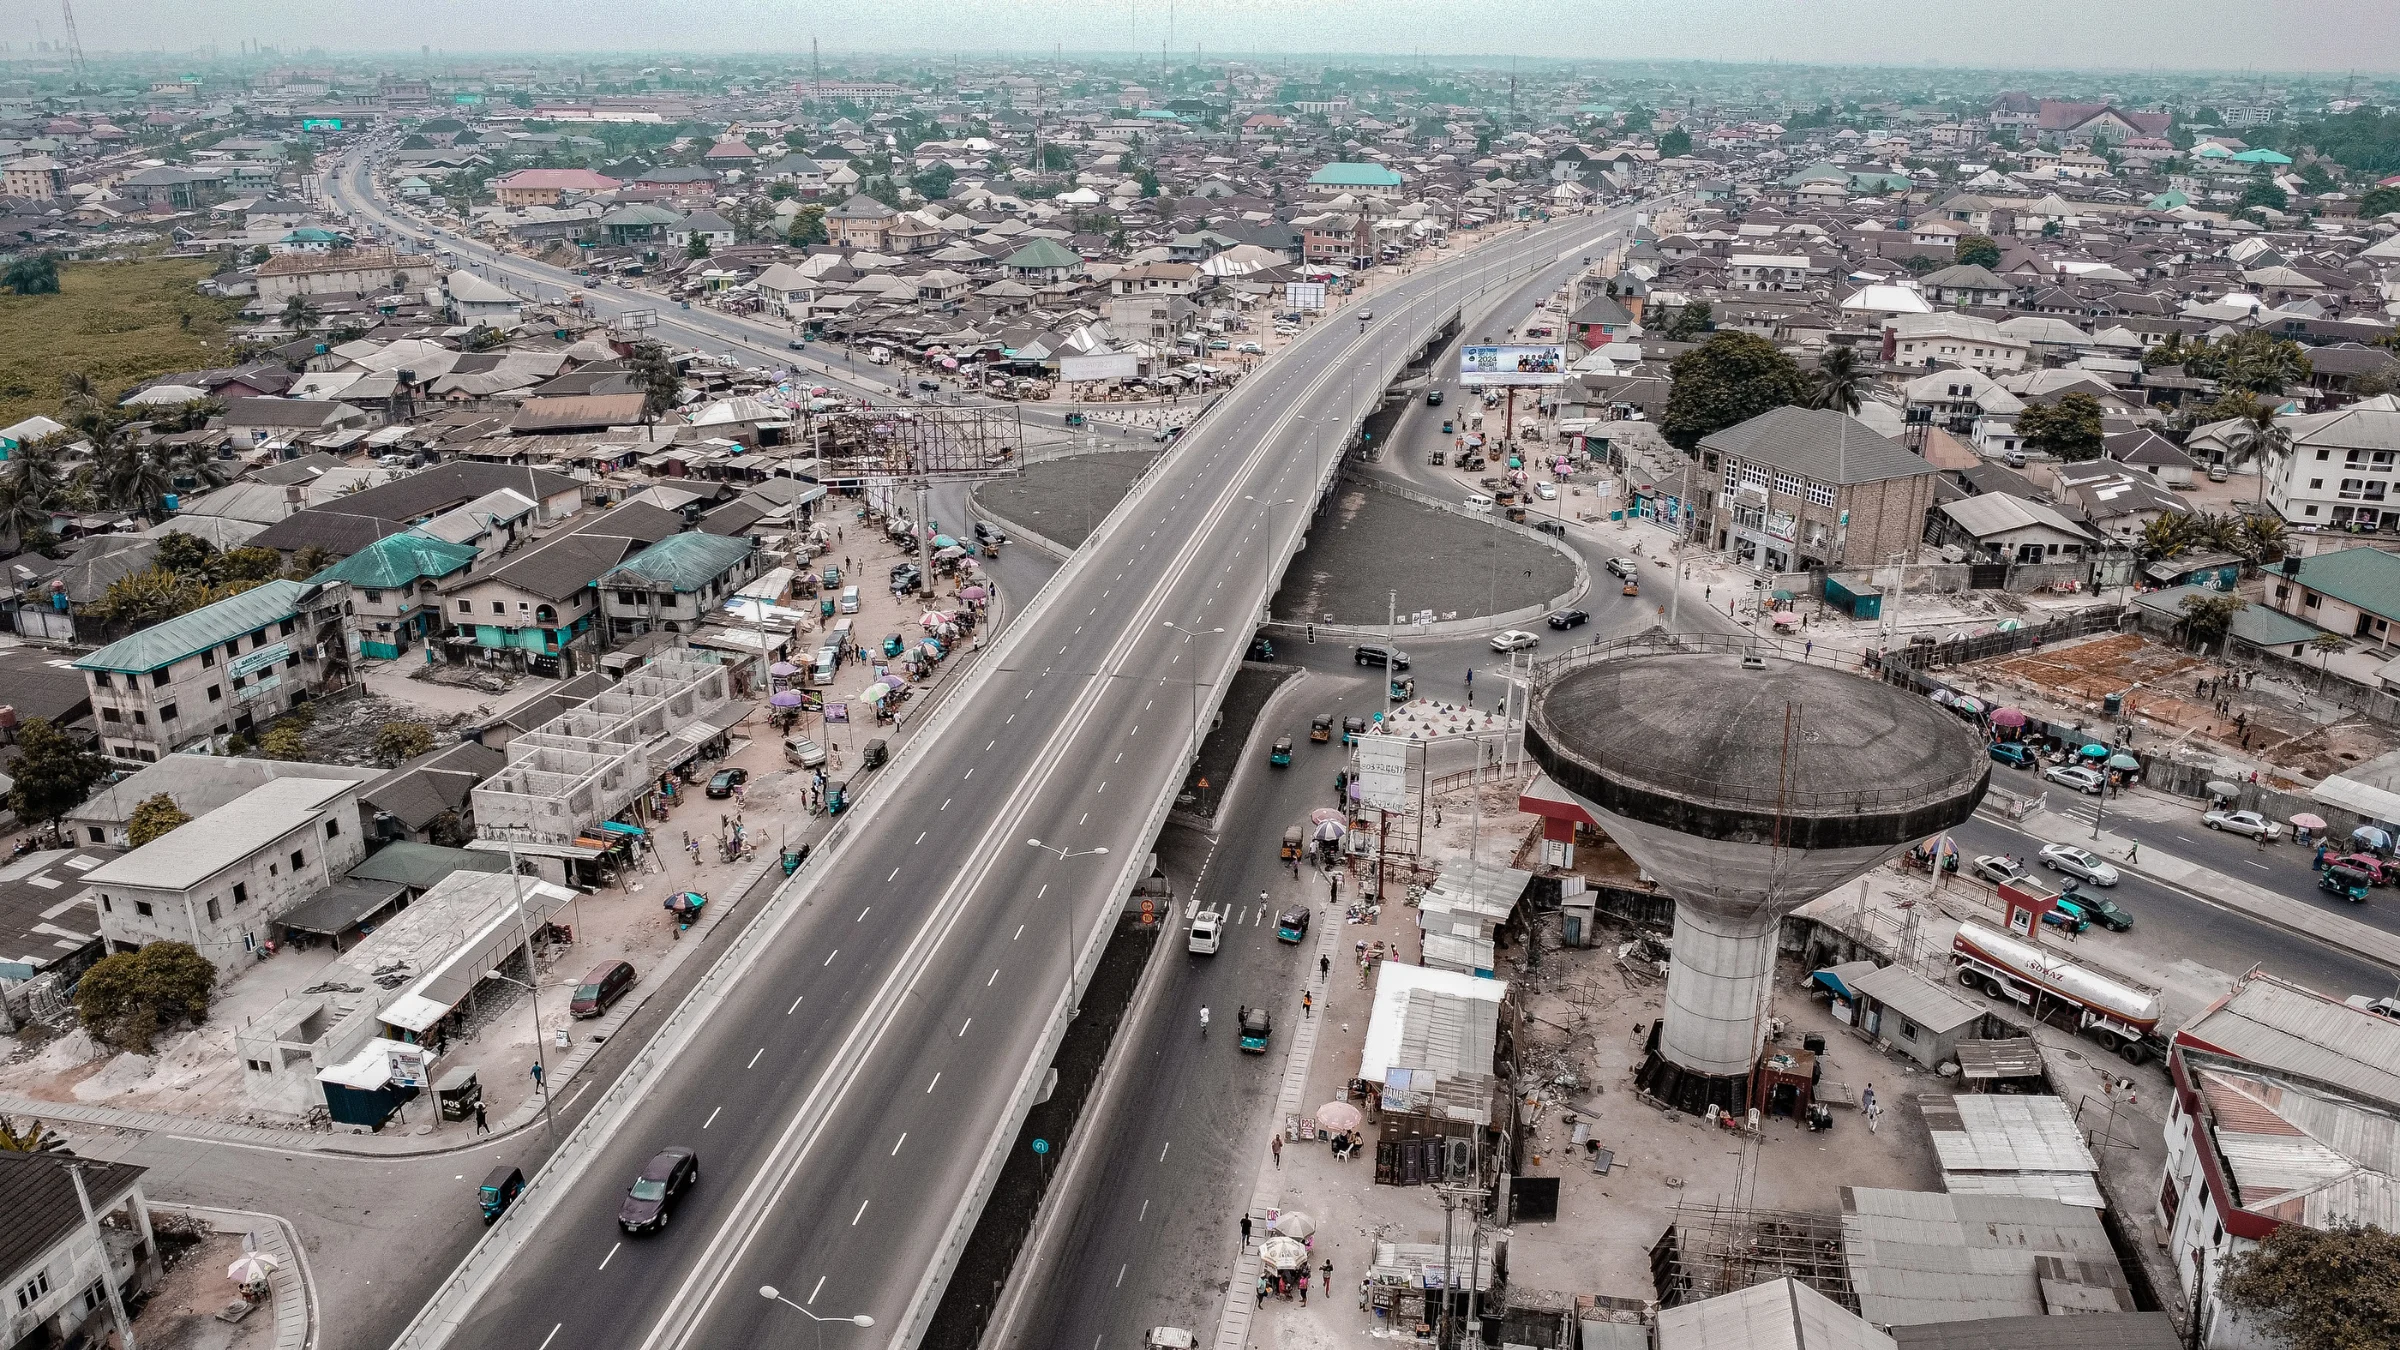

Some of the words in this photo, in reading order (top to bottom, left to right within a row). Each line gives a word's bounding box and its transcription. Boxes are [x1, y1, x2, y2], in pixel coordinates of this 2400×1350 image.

[241, 652, 264, 666] GATEWAY
[442, 1099, 461, 1109] POS
[1267, 1209, 1279, 1221] POS
